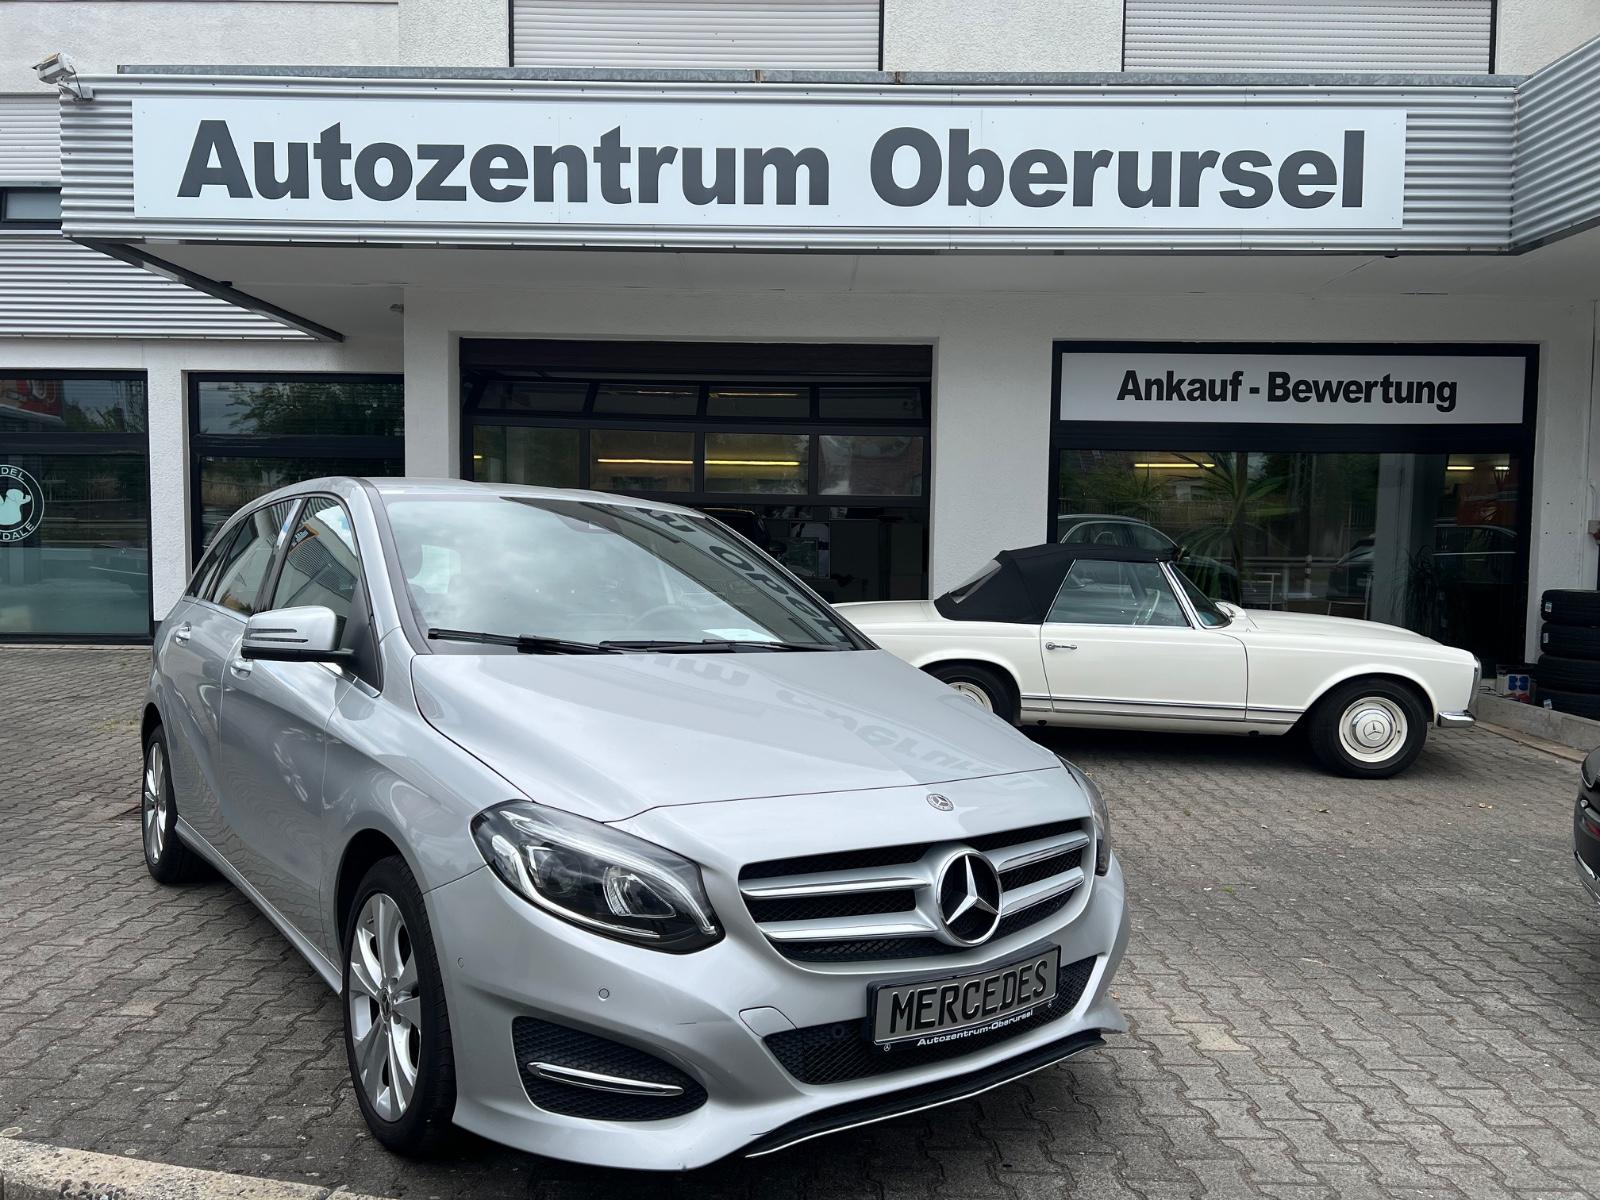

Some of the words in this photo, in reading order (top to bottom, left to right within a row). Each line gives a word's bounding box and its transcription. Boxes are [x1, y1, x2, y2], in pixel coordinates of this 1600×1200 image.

[177, 119, 829, 206] Autozentrum
[870, 127, 1365, 209] Oberursel
[1116, 369, 1244, 402] Ankauf
[1267, 371, 1458, 413] Bewertung
[889, 959, 1048, 1034] MERCEDES
[916, 1009, 1034, 1047] Autozentrum-Oberursel
